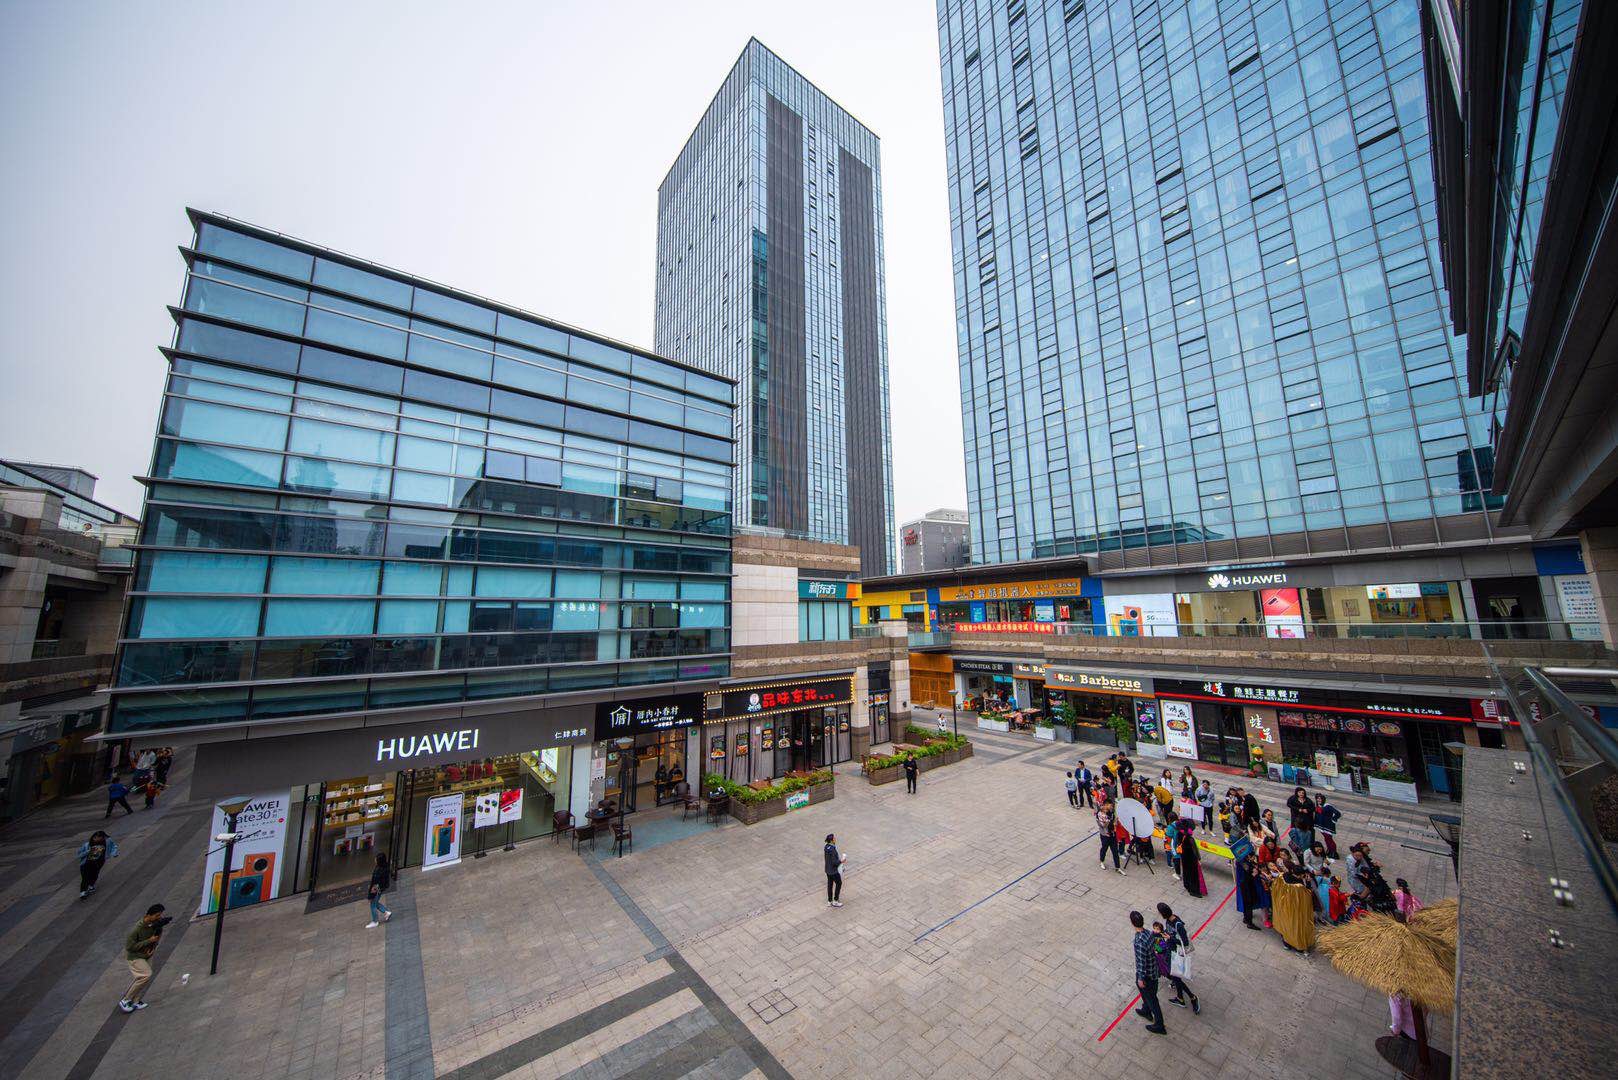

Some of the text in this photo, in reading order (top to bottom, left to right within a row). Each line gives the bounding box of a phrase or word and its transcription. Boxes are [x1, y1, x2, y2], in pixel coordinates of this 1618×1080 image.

[1232, 573, 1287, 585] HUAWEI
[1080, 674, 1141, 689] Barbecue
[377, 728, 480, 762] HUAWEI
